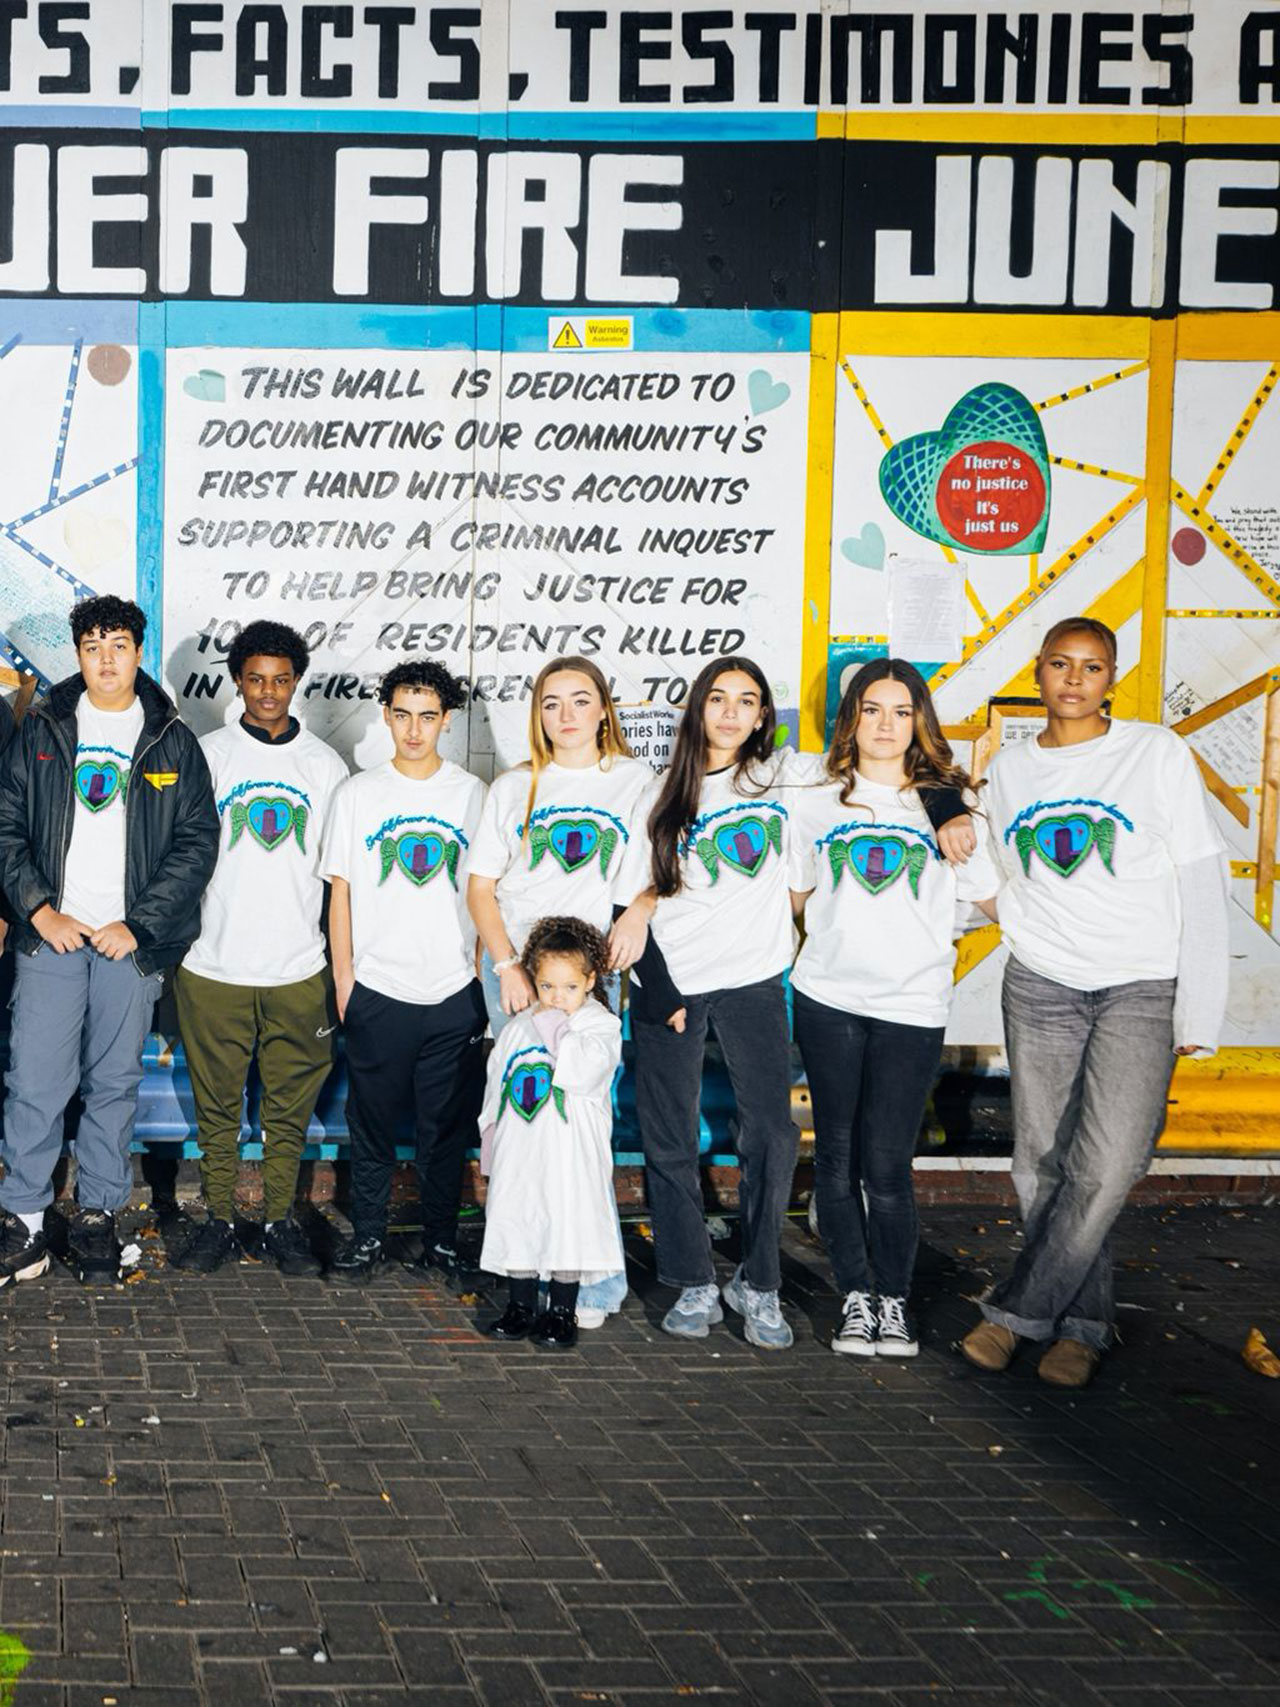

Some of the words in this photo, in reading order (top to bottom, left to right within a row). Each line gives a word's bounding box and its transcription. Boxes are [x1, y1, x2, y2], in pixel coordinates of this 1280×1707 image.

[555, 10, 1194, 106] TESTIMONIES
[333, 147, 683, 302] FIRE
[874, 155, 1280, 310] JUNE
[587, 324, 629, 335] Warning
[241, 367, 325, 400] THIS
[331, 367, 426, 400] WALL
[451, 367, 492, 400] IS
[505, 371, 680, 402] DEDICATED
[691, 372, 736, 402] TO
[198, 419, 444, 450] DOCUMENTING
[454, 419, 522, 450] OUR
[534, 416, 768, 454] COMMUNITY'S
[964, 455, 1021, 470] There's
[197, 470, 298, 499] FIRST
[304, 470, 400, 500] HAND
[406, 470, 565, 502] WITNESS
[571, 472, 750, 506] ACCOUNTS
[951, 478, 971, 490] no
[976, 476, 1029, 493] justice
[976, 501, 1000, 515] It's
[178, 517, 396, 550] SUPPORTING
[405, 520, 432, 551] A
[450, 521, 622, 555] CRIMINAL
[638, 528, 776, 558] INQUEST
[964, 518, 995, 536] just
[1000, 521, 1020, 533] us
[223, 570, 271, 601] TO
[279, 570, 380, 601] HELP
[383, 569, 502, 602] BRING
[523, 572, 674, 605] JUSTICE
[680, 577, 747, 606] FOR
[197, 617, 242, 654] 10
[303, 620, 355, 653] OF
[374, 621, 606, 656] RESIDENTS
[618, 624, 746, 656] KILLED
[182, 672, 224, 700] IN
[304, 672, 381, 701] FIRE
[620, 721, 653, 739] ories
[653, 744, 670, 758] on
